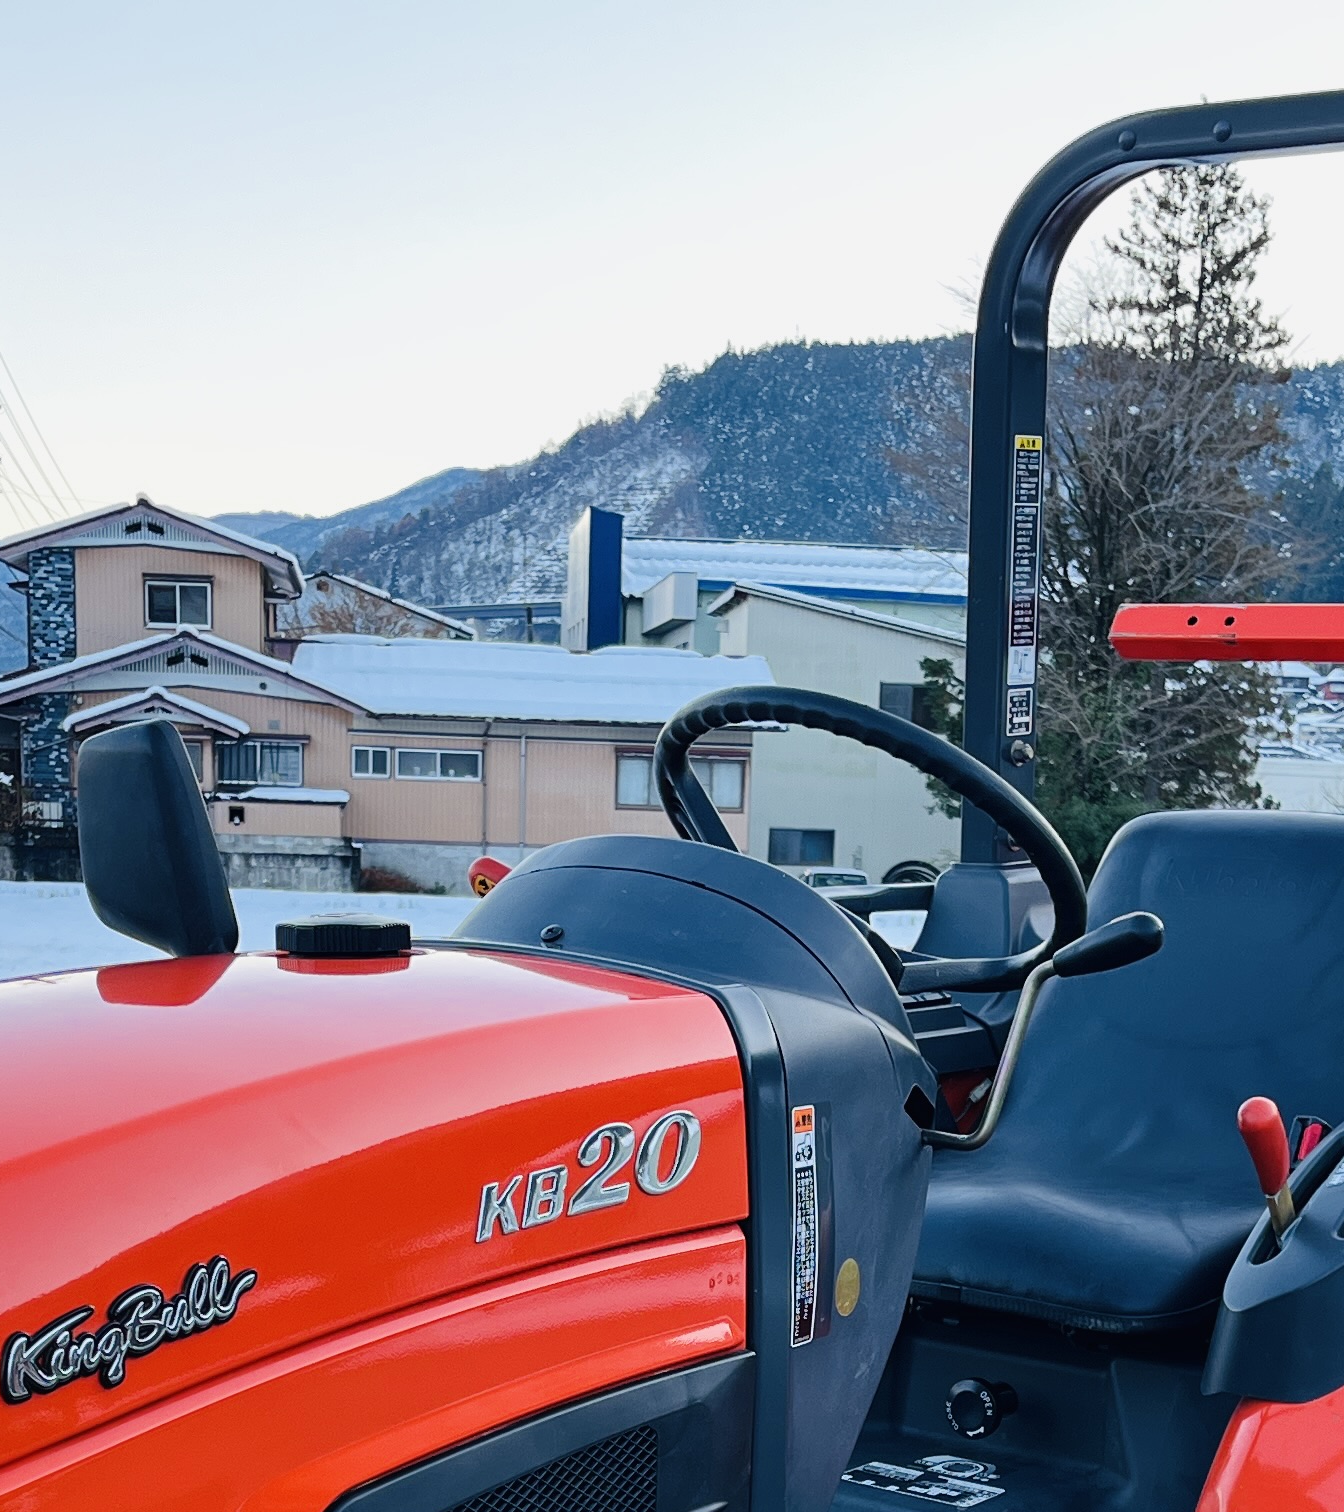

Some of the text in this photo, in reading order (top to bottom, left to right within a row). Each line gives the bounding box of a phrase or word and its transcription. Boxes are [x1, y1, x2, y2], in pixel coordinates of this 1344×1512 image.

[475, 1109, 700, 1244] KB20
[0, 1255, 257, 1403] KingBull
[980, 1391, 993, 1415] OPEN
